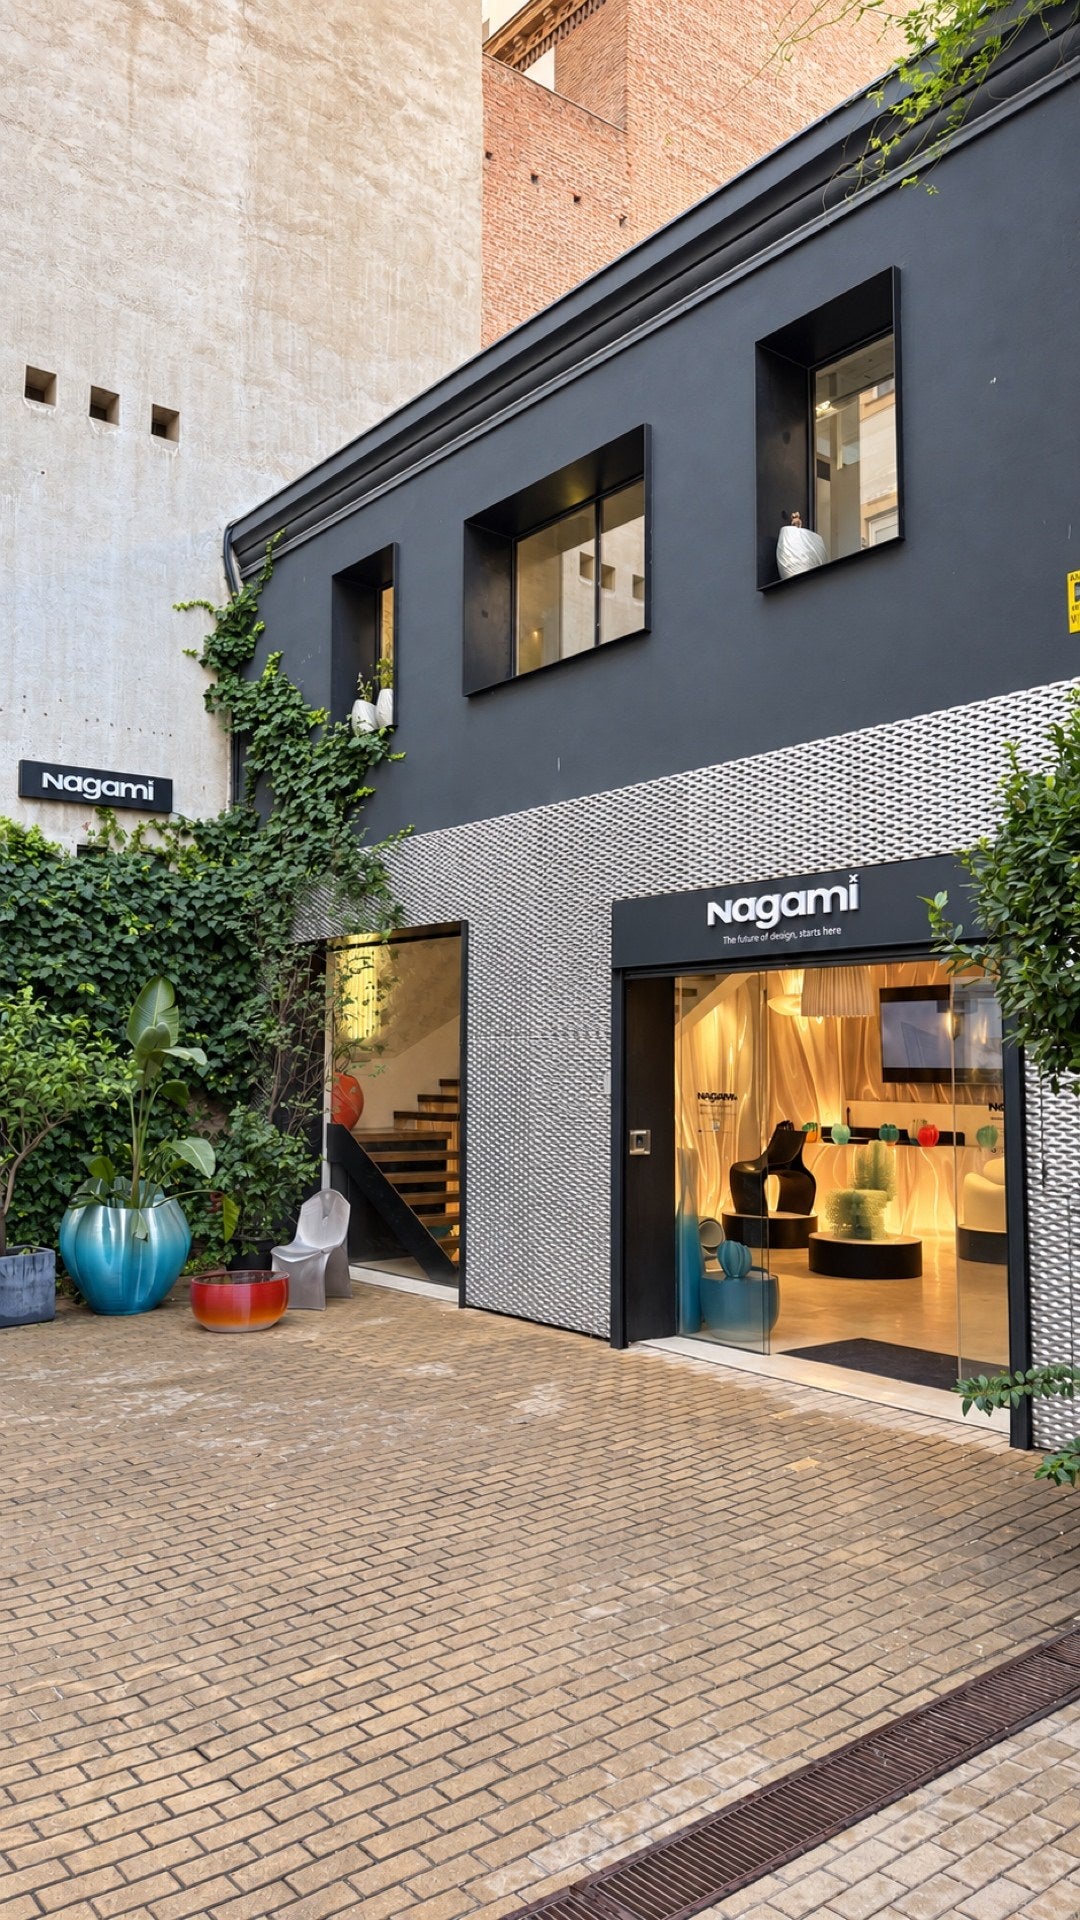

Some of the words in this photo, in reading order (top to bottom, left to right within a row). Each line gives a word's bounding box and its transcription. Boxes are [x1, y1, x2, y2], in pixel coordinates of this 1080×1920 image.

[41, 772, 155, 801] Nagami
[707, 874, 860, 930] Nagami
[723, 935, 737, 945] The
[737, 934, 760, 944] future
[760, 932, 769, 942] of
[799, 928, 821, 938] starts
[822, 925, 842, 936] here
